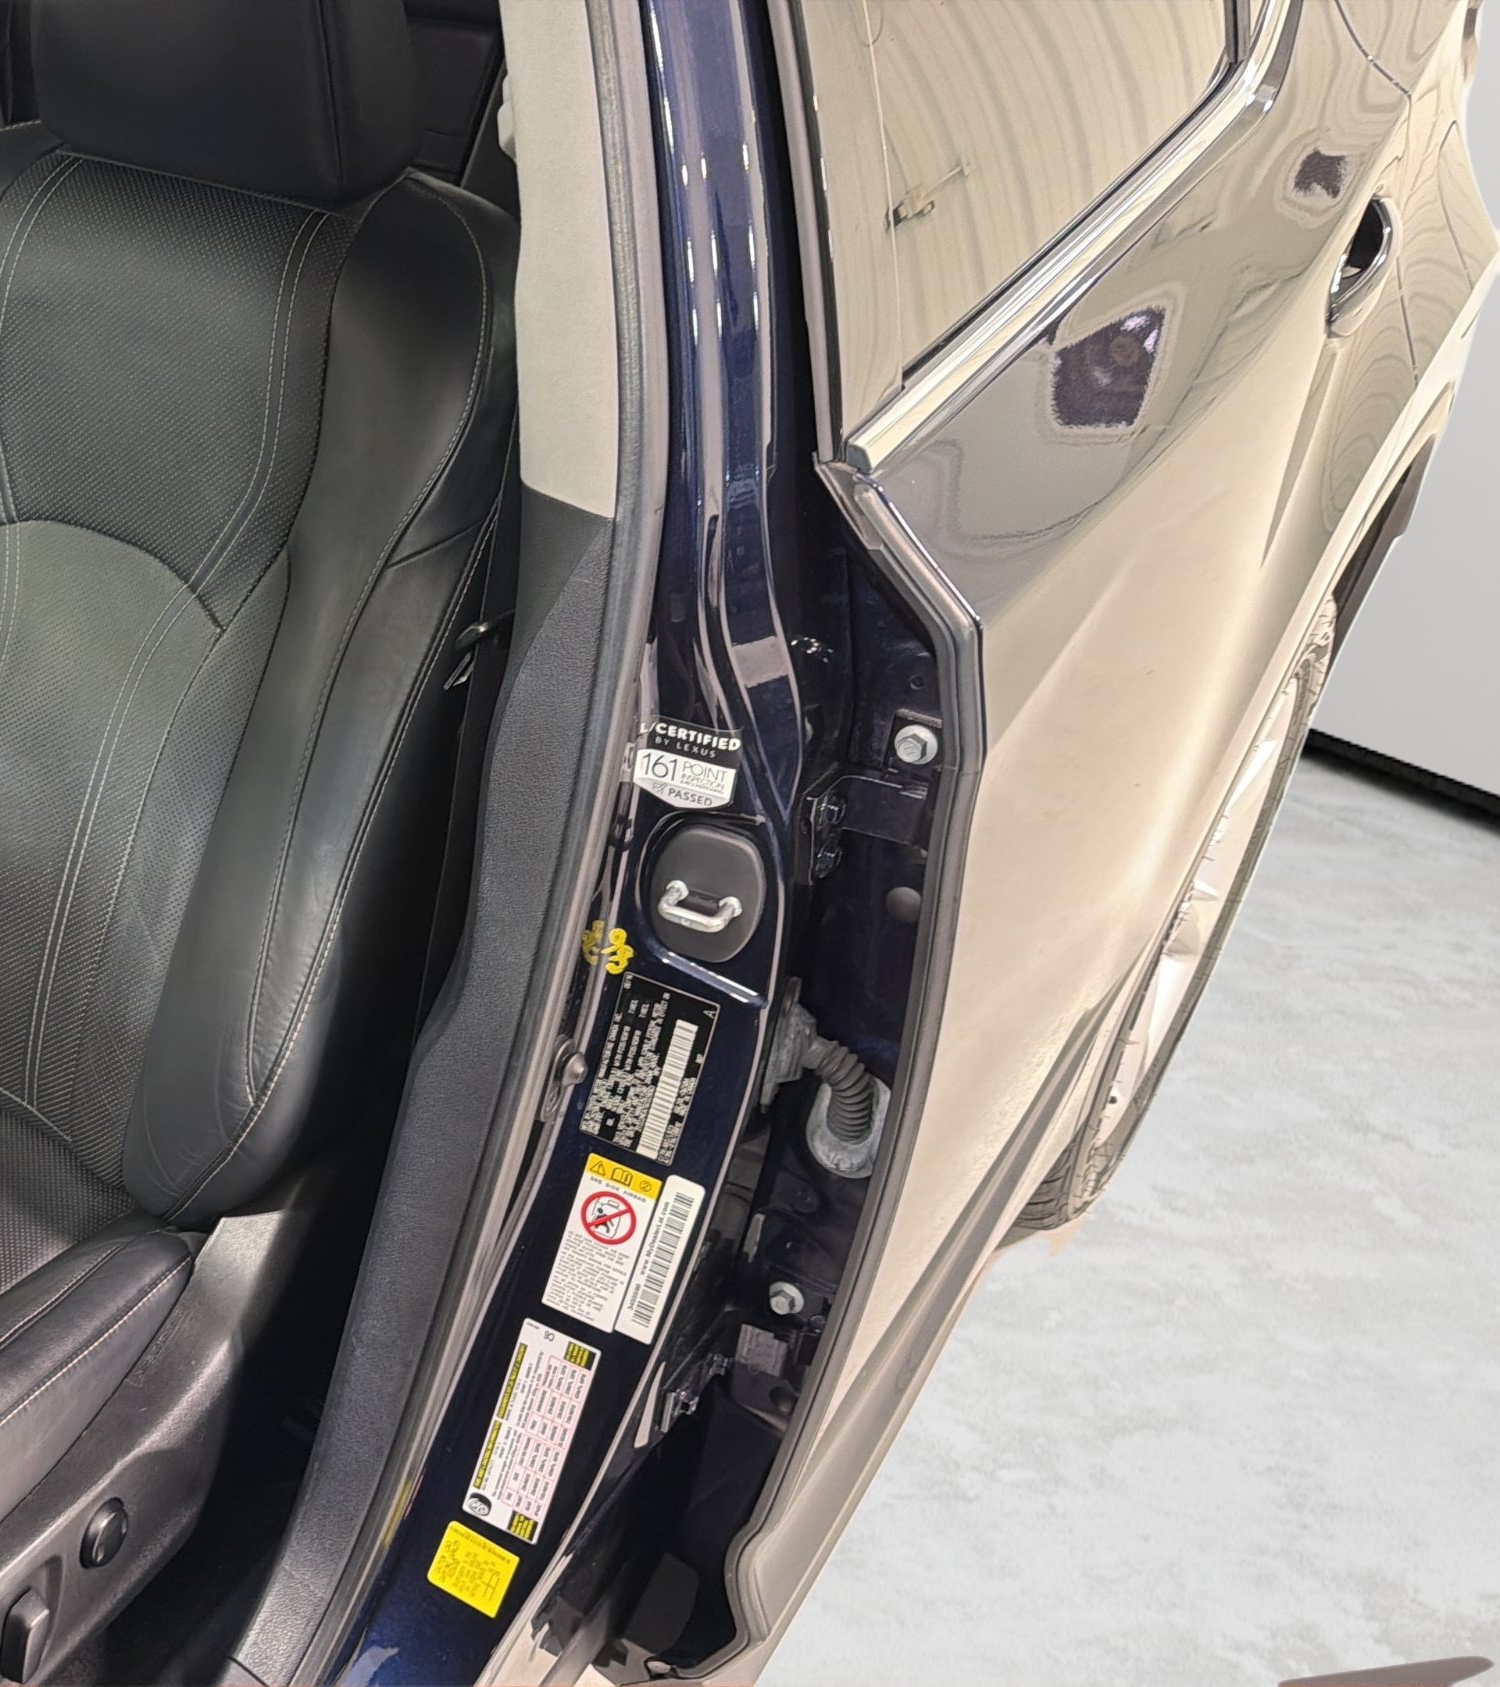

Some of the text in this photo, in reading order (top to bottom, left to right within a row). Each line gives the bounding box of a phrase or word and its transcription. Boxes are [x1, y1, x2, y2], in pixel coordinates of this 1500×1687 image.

[640, 722, 741, 751] L/CERTIFIED
[655, 736, 716, 758] BY LEXUS
[642, 752, 728, 782] 161 POINT
[668, 788, 712, 806] PASSED
[703, 1010, 716, 1019] A
